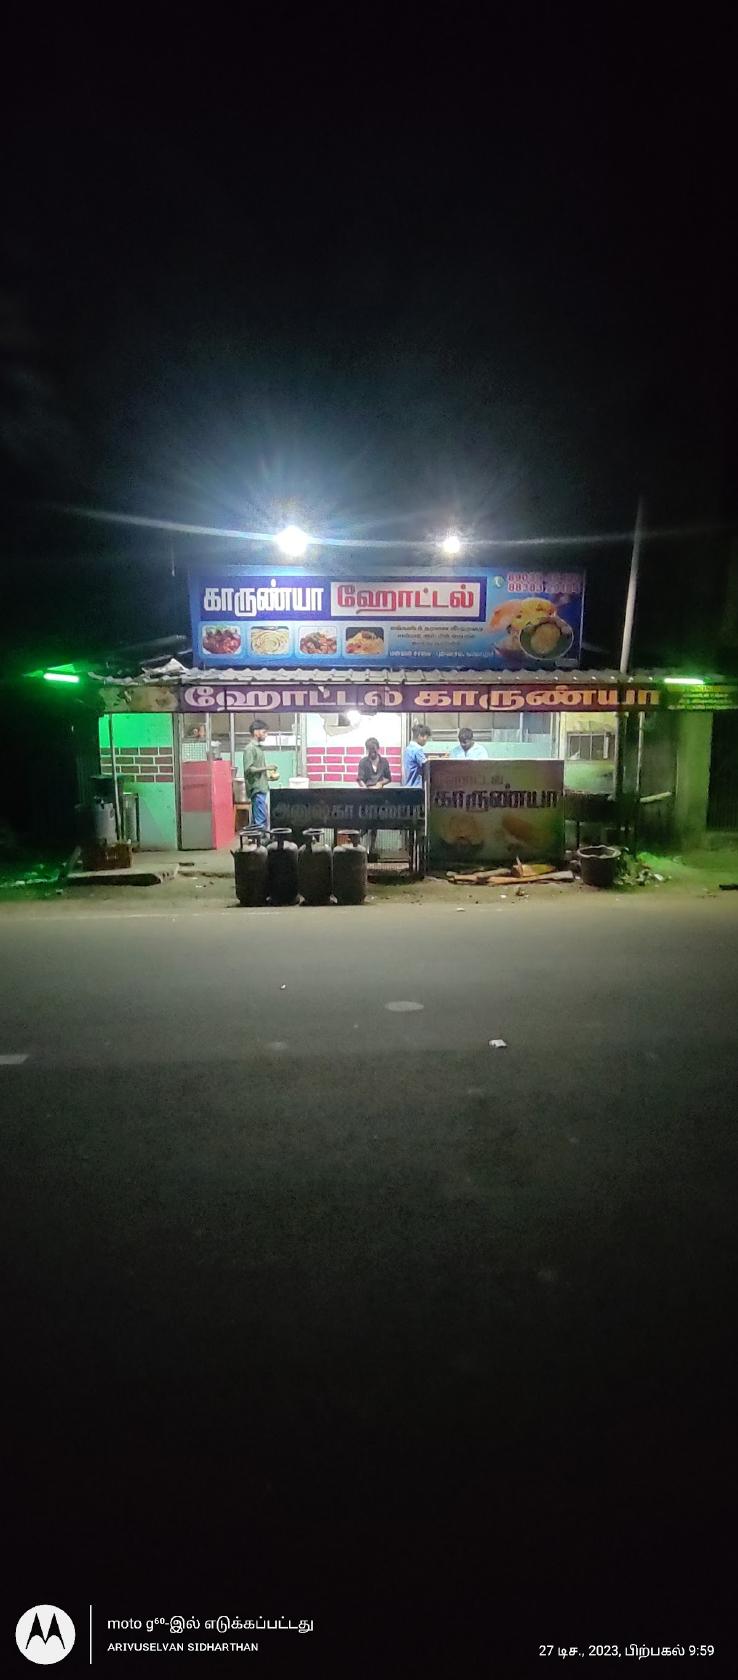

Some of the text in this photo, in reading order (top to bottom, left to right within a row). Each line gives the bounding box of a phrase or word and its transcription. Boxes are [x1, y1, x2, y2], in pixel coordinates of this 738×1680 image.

[203, 579, 475, 617] காருண்யா ஹோட்டல்
[184, 686, 404, 712] ஹோட்டல்
[414, 685, 660, 711] காருண்யா
[433, 783, 558, 811] காருண்யா
